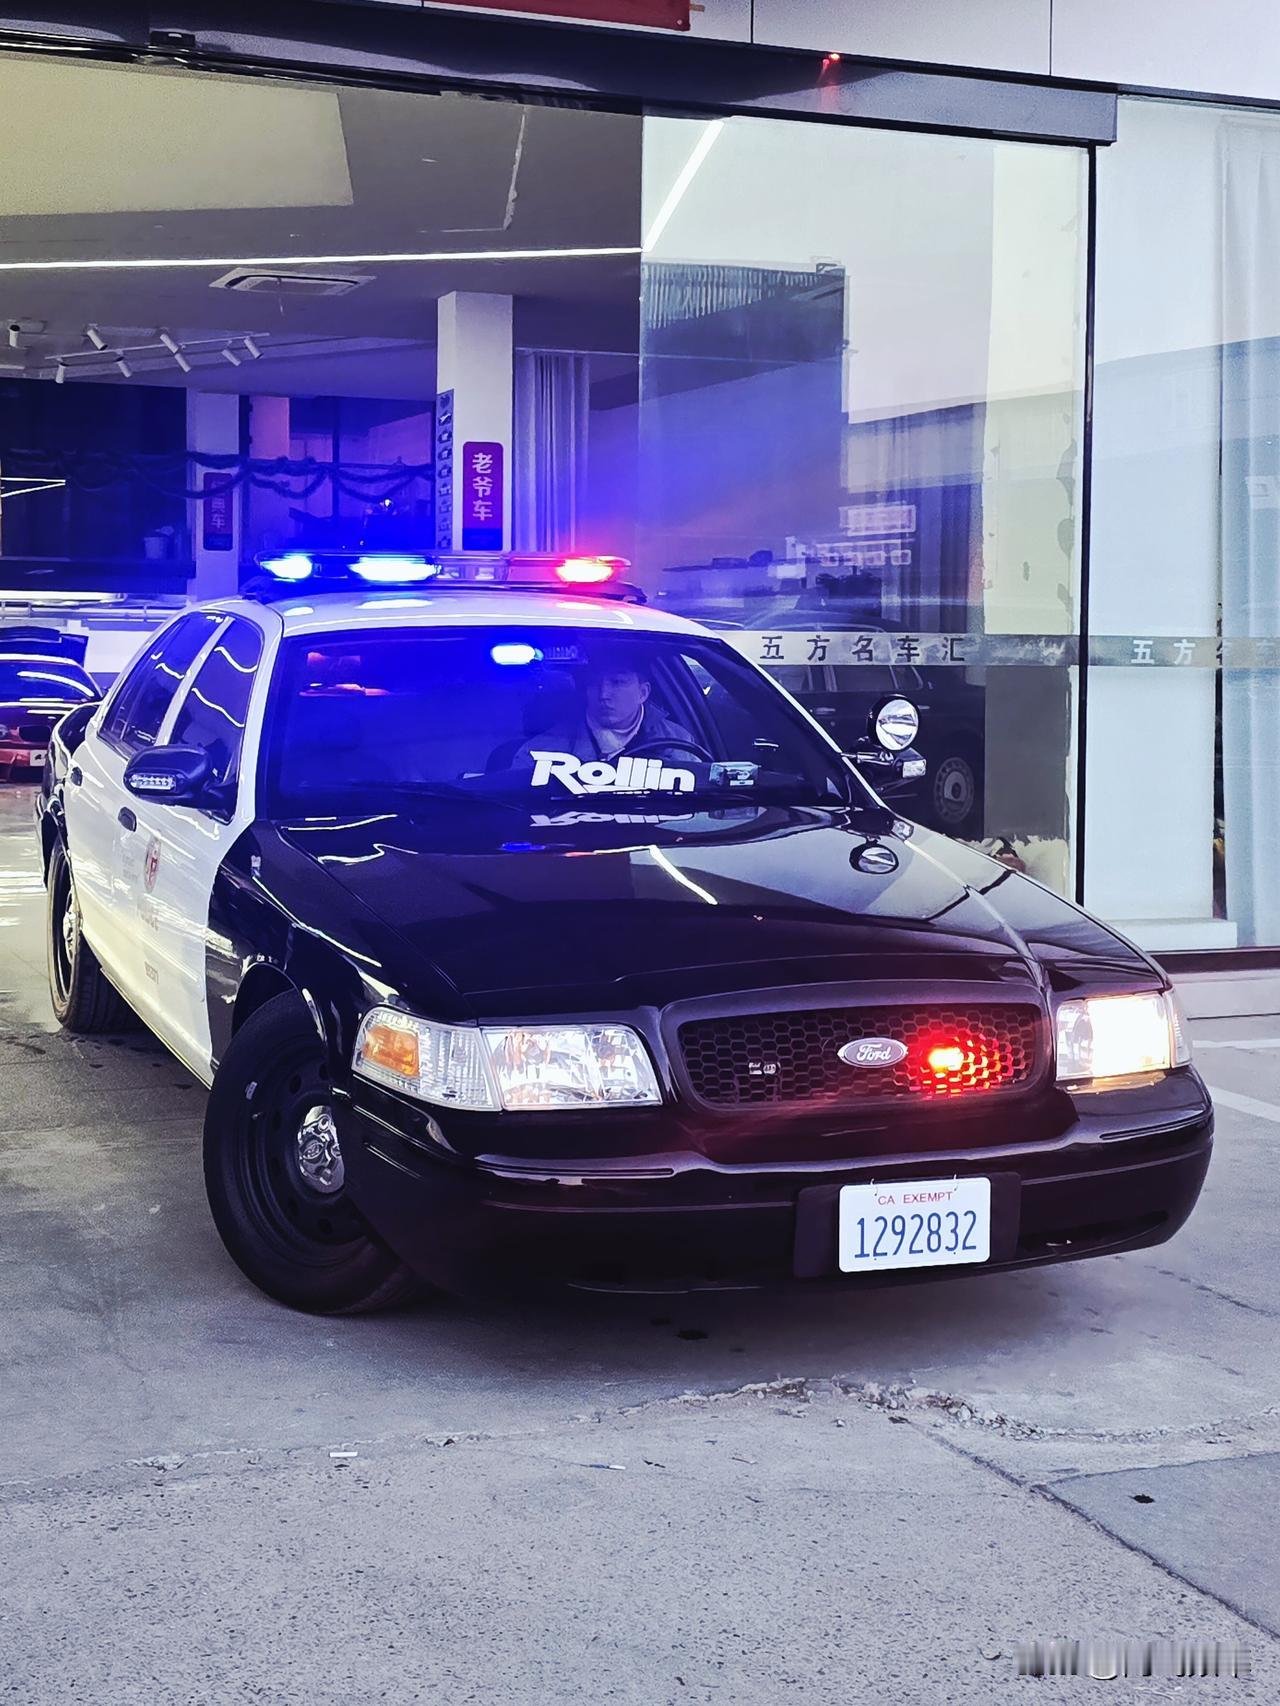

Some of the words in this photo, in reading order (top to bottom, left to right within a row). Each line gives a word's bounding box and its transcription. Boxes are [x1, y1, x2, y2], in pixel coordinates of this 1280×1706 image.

[472, 453, 494, 521] 老爷车
[760, 635, 965, 662] 五方名车汇
[530, 750, 695, 795] Rollin
[857, 1043, 891, 1062] Ford
[878, 1195, 895, 1206] CA
[903, 1191, 953, 1204] EXEMPT
[854, 1210, 977, 1259] 1292832
